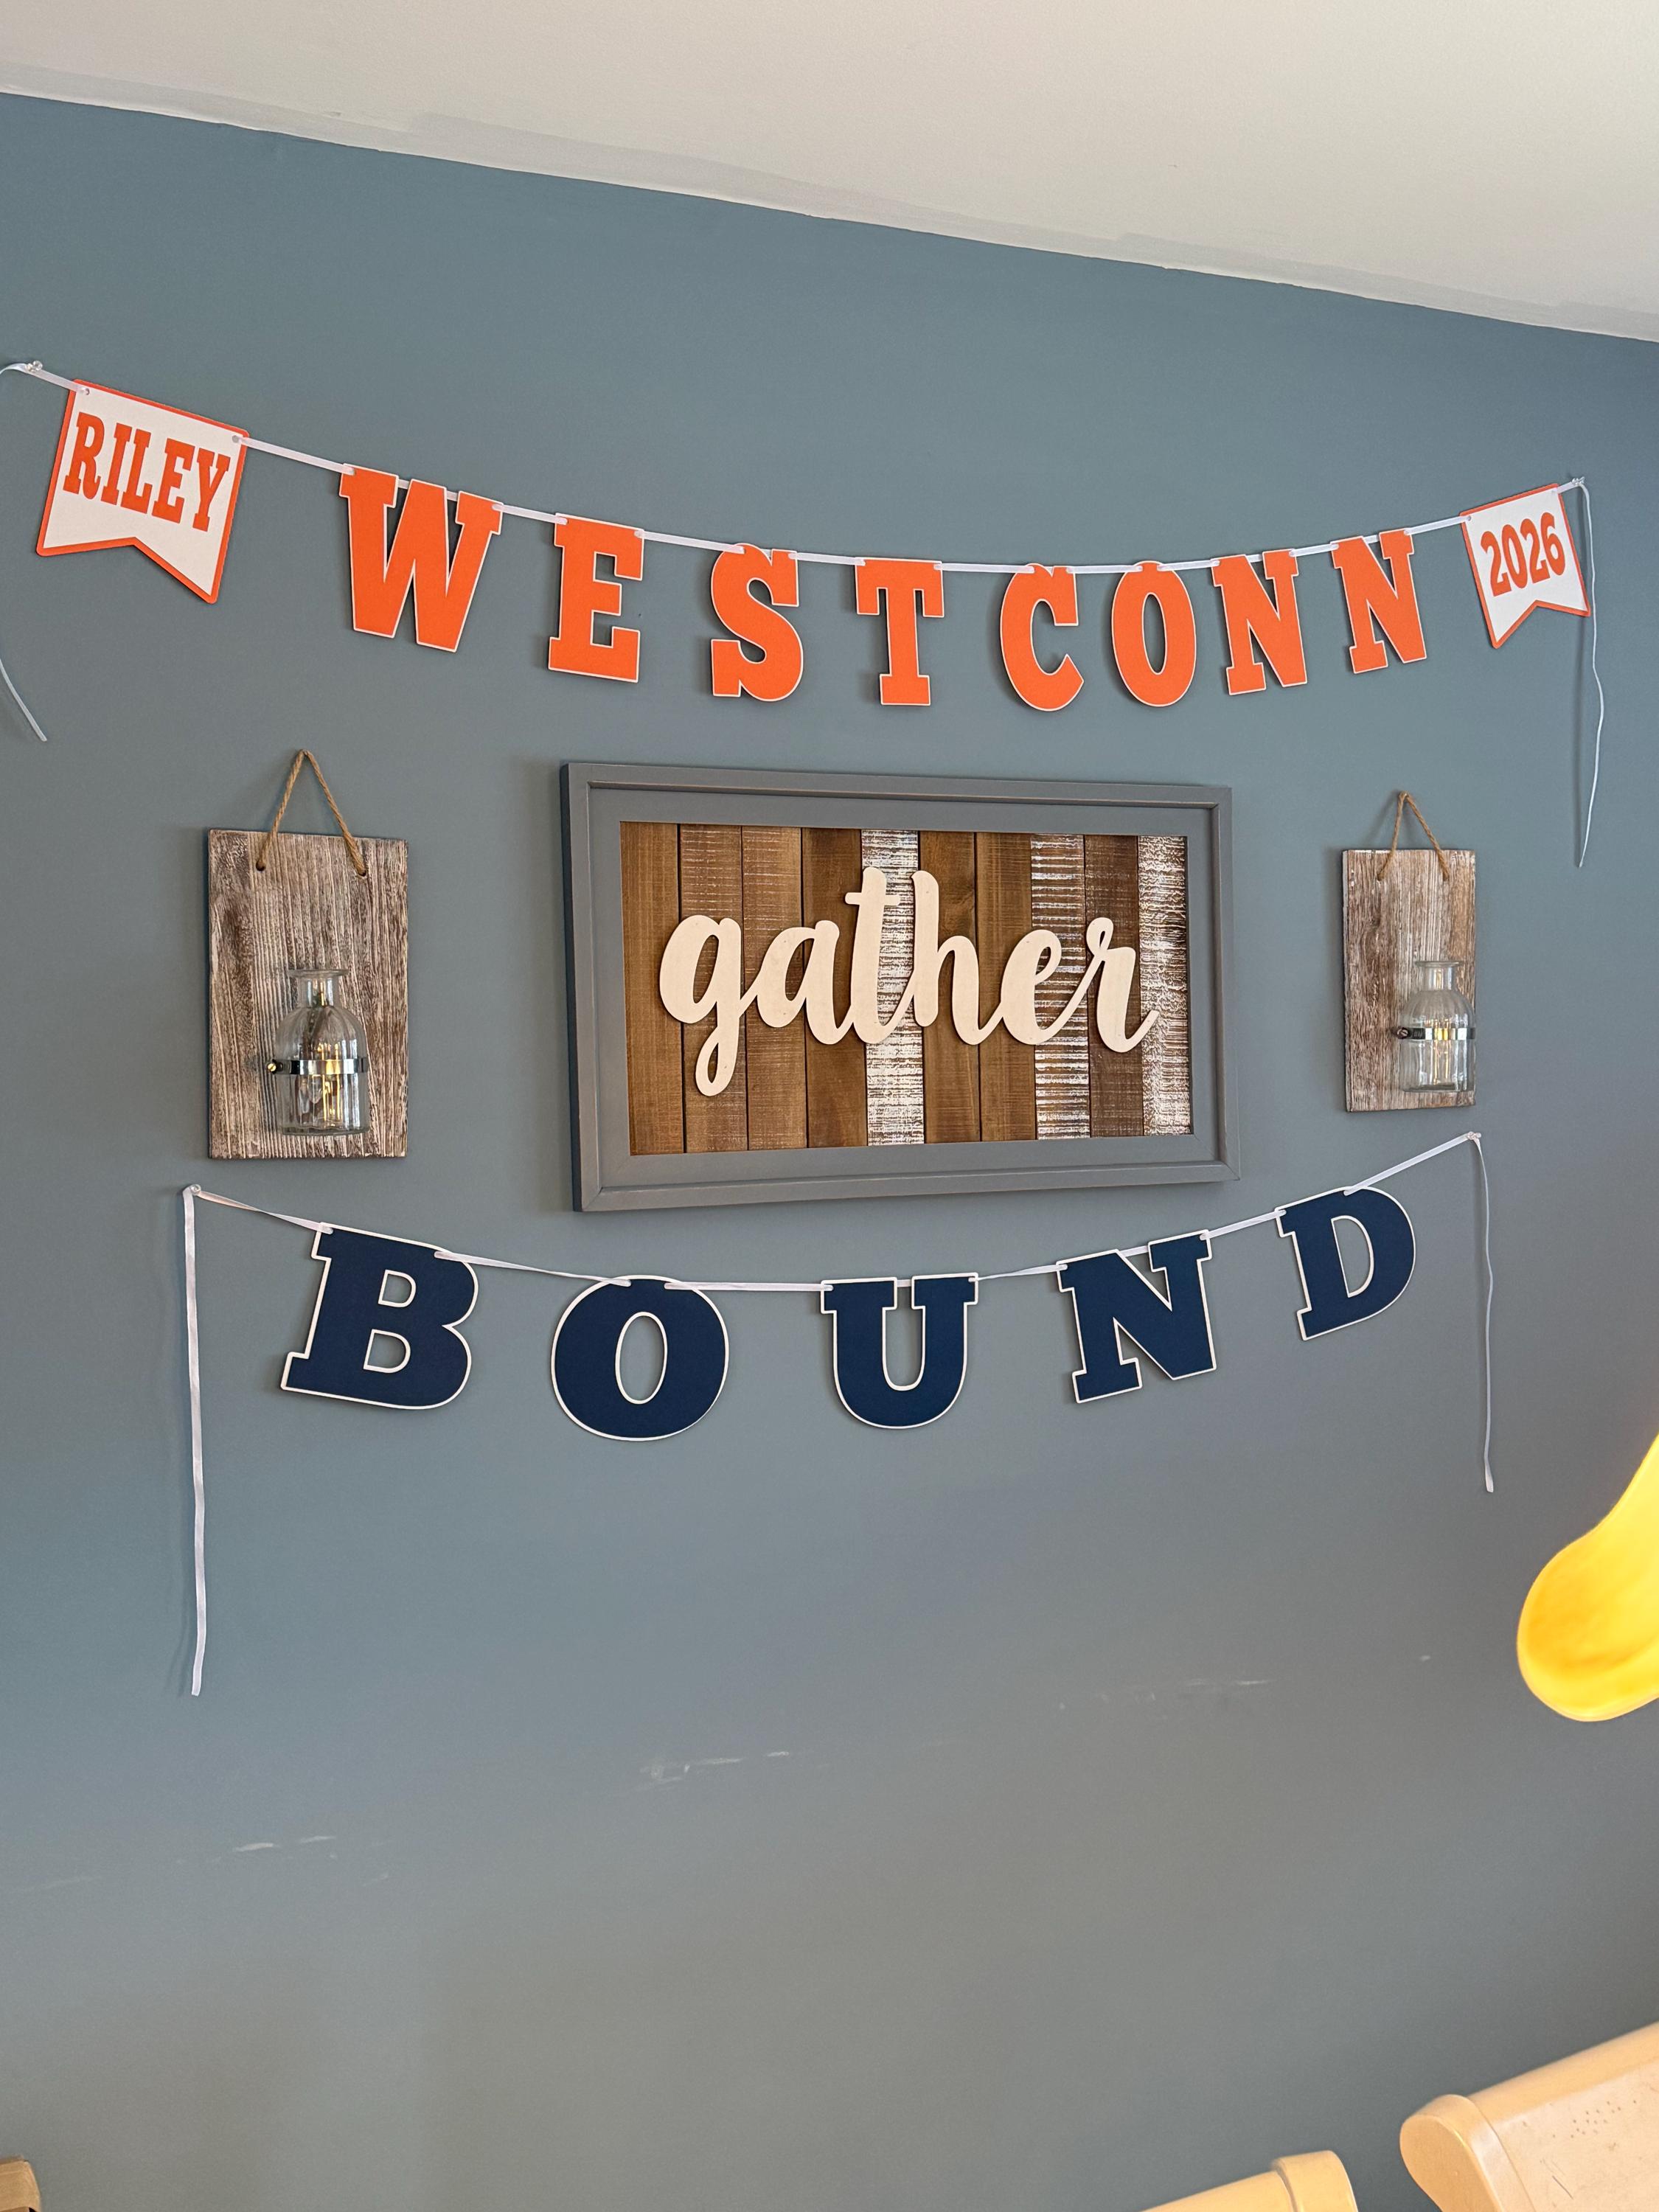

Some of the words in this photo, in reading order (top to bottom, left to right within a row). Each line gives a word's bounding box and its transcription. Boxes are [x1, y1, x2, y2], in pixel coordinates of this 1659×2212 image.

[63, 412, 230, 532] RILEY
[339, 463, 1427, 711] WESTCONN
[1480, 512, 1565, 597] 2026
[659, 866, 1159, 1096] gather
[280, 1186, 1416, 1441] BOUND
